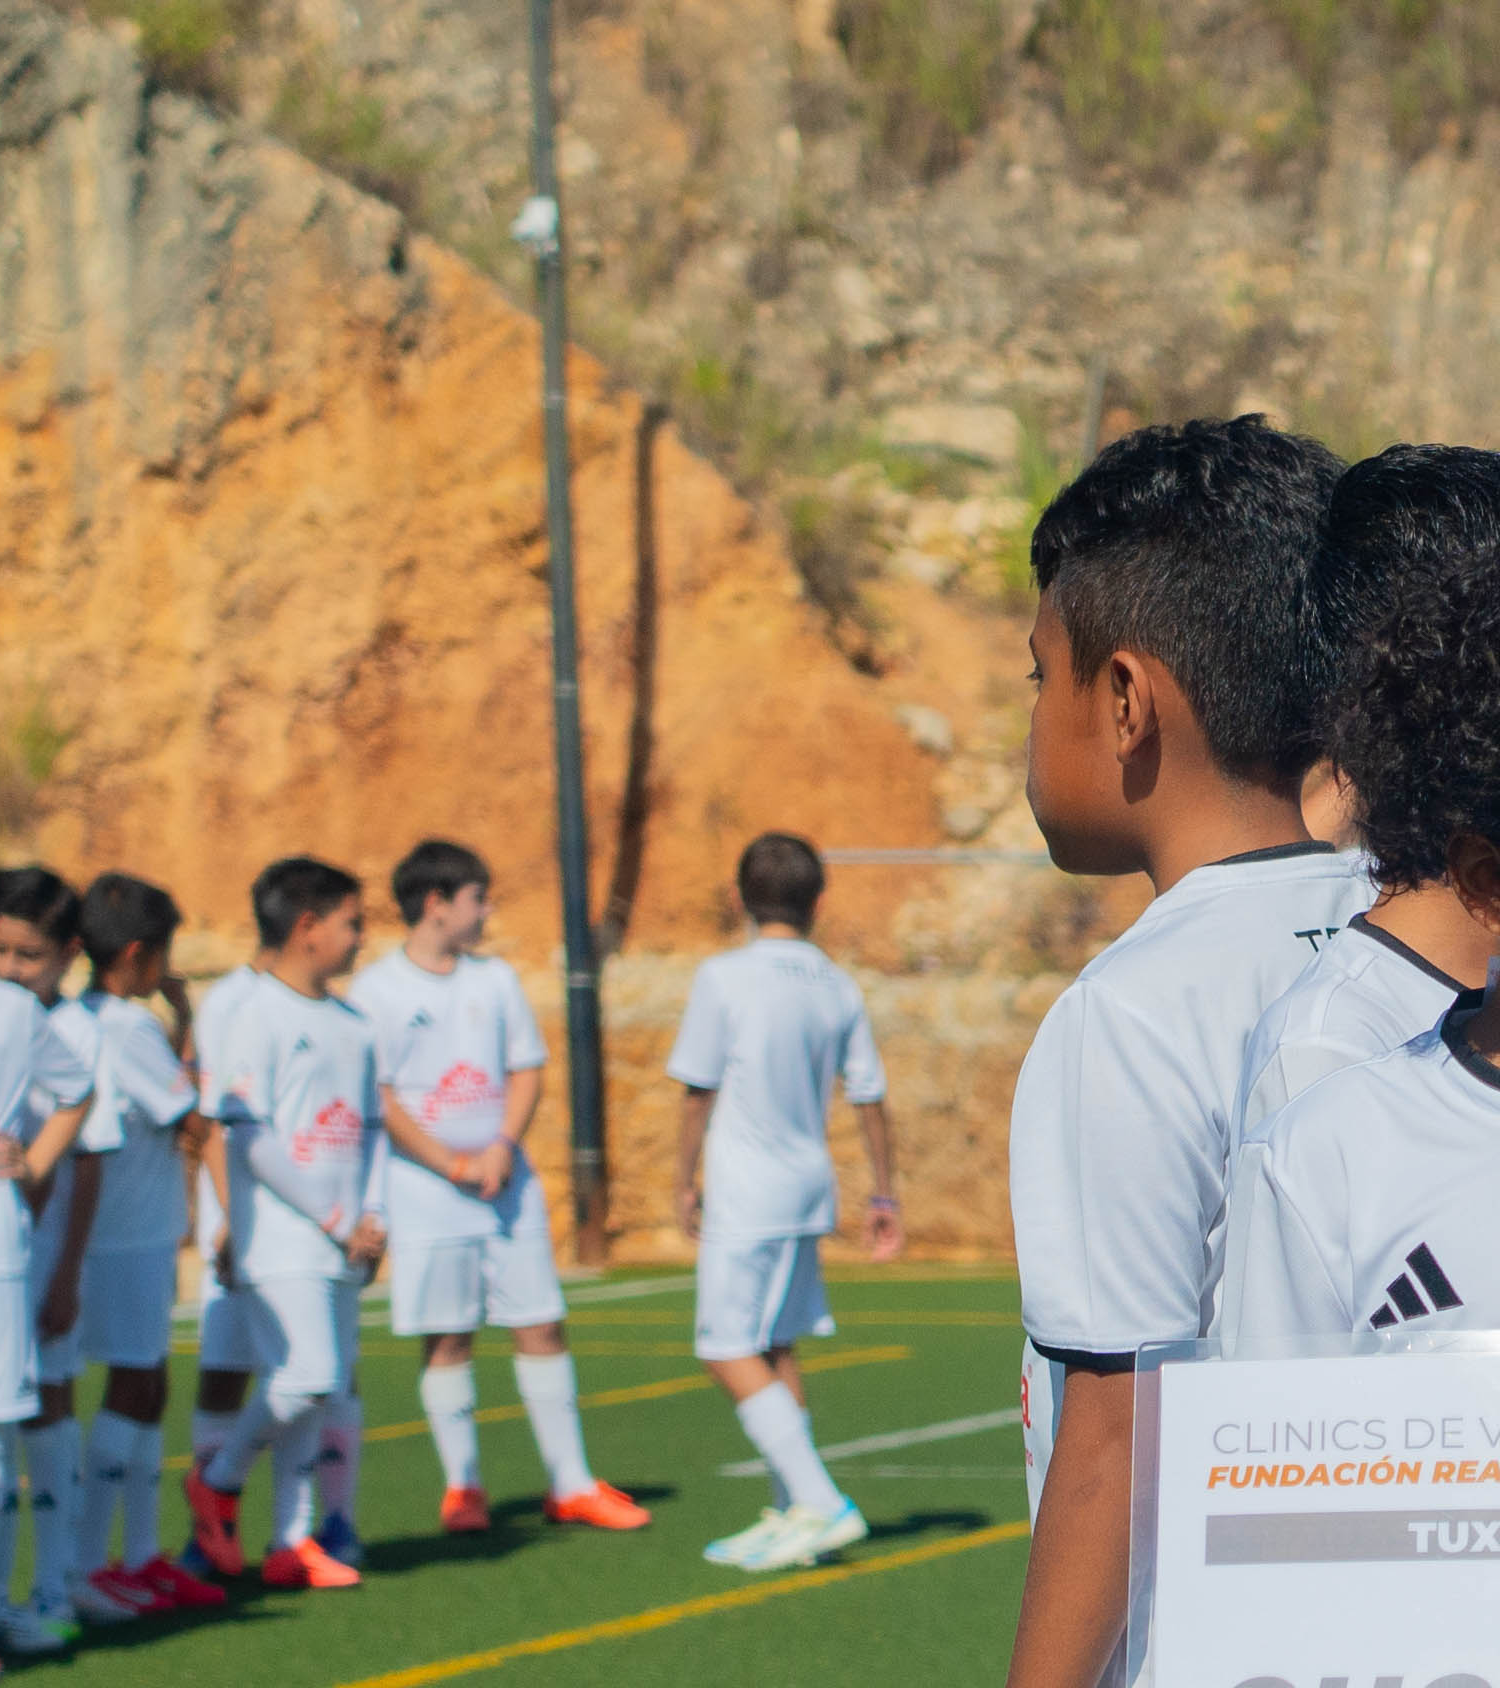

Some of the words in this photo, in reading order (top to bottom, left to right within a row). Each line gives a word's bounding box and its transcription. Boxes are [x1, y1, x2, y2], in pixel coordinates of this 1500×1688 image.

[1211, 1417, 1389, 1455] CLINICS
[1404, 1416, 1464, 1450] DE
[1206, 1455, 1423, 1490] FUNDACIÓN
